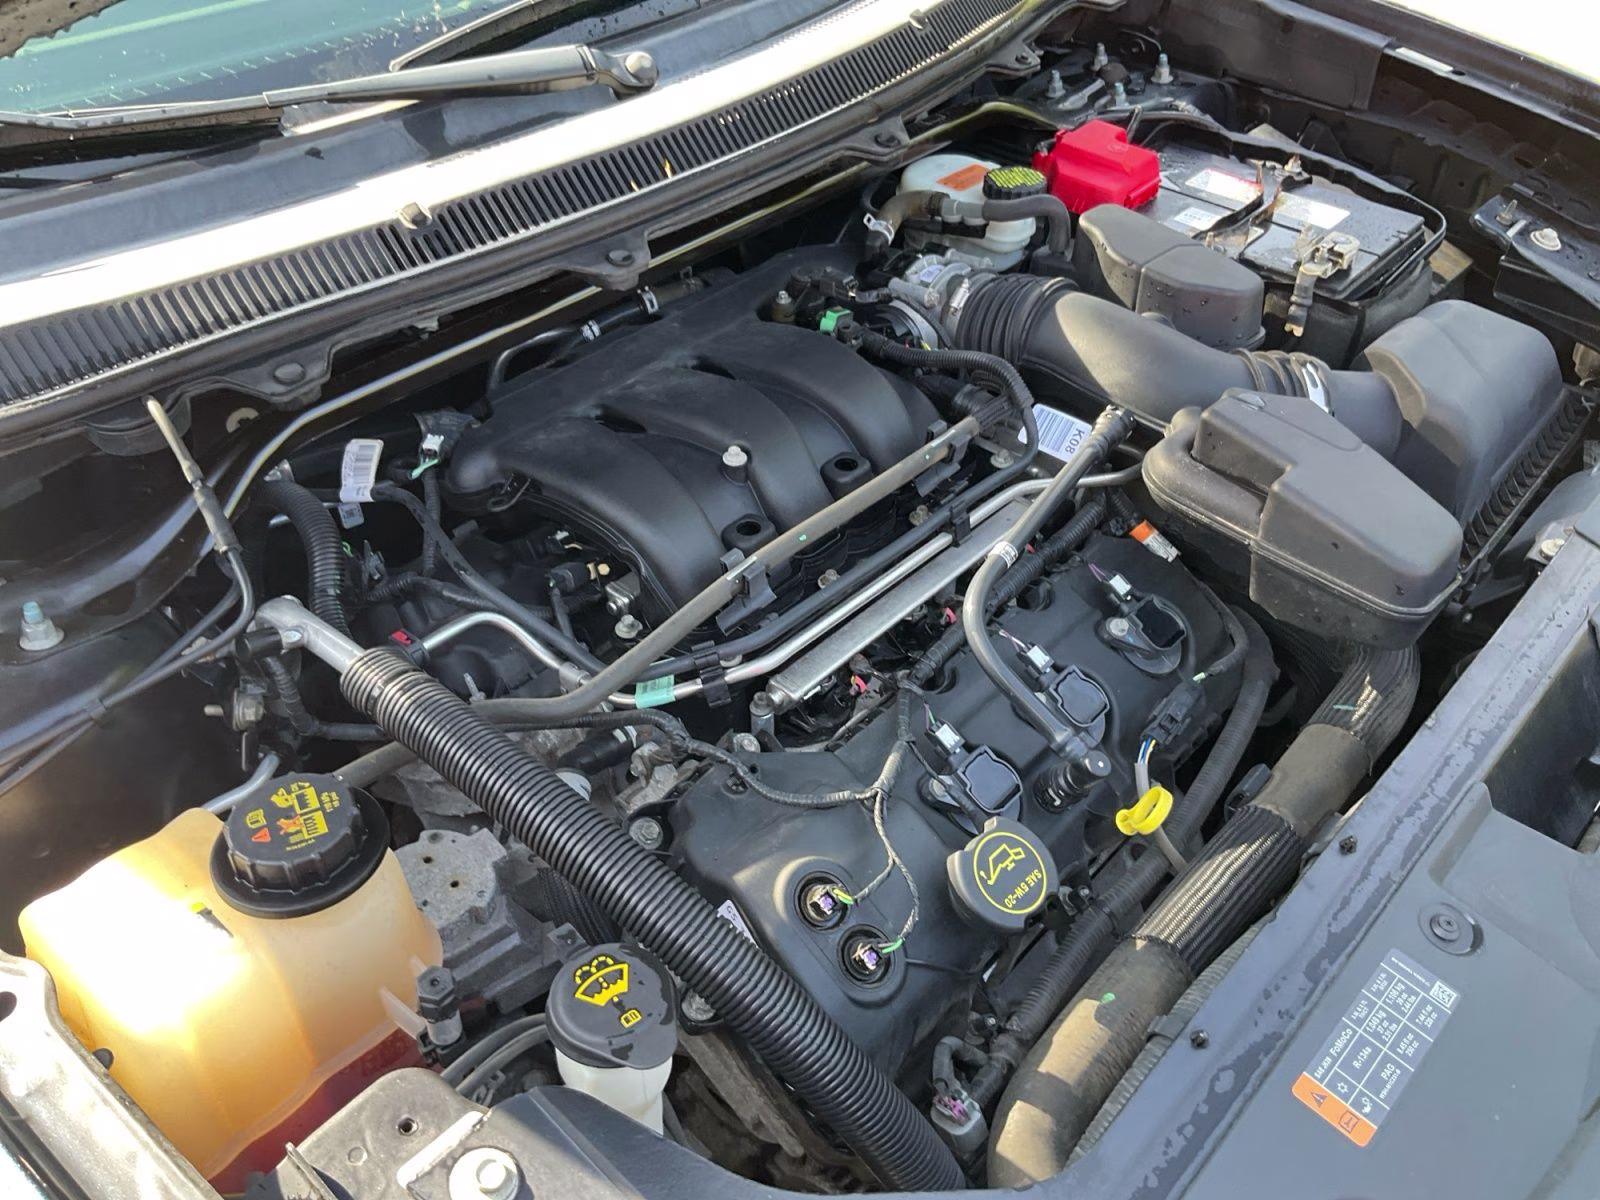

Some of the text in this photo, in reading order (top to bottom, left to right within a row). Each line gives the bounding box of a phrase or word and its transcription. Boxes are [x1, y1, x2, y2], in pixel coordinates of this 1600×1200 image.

[1065, 428, 1085, 454] K08
[1025, 869, 1041, 887] SAE
[1393, 981, 1405, 992] kg
[1374, 1008, 1387, 1020] kg
[1329, 1028, 1353, 1057] FoMoCo
[1353, 1046, 1372, 1069] R-134a
[1380, 1063, 1396, 1080] PAG
